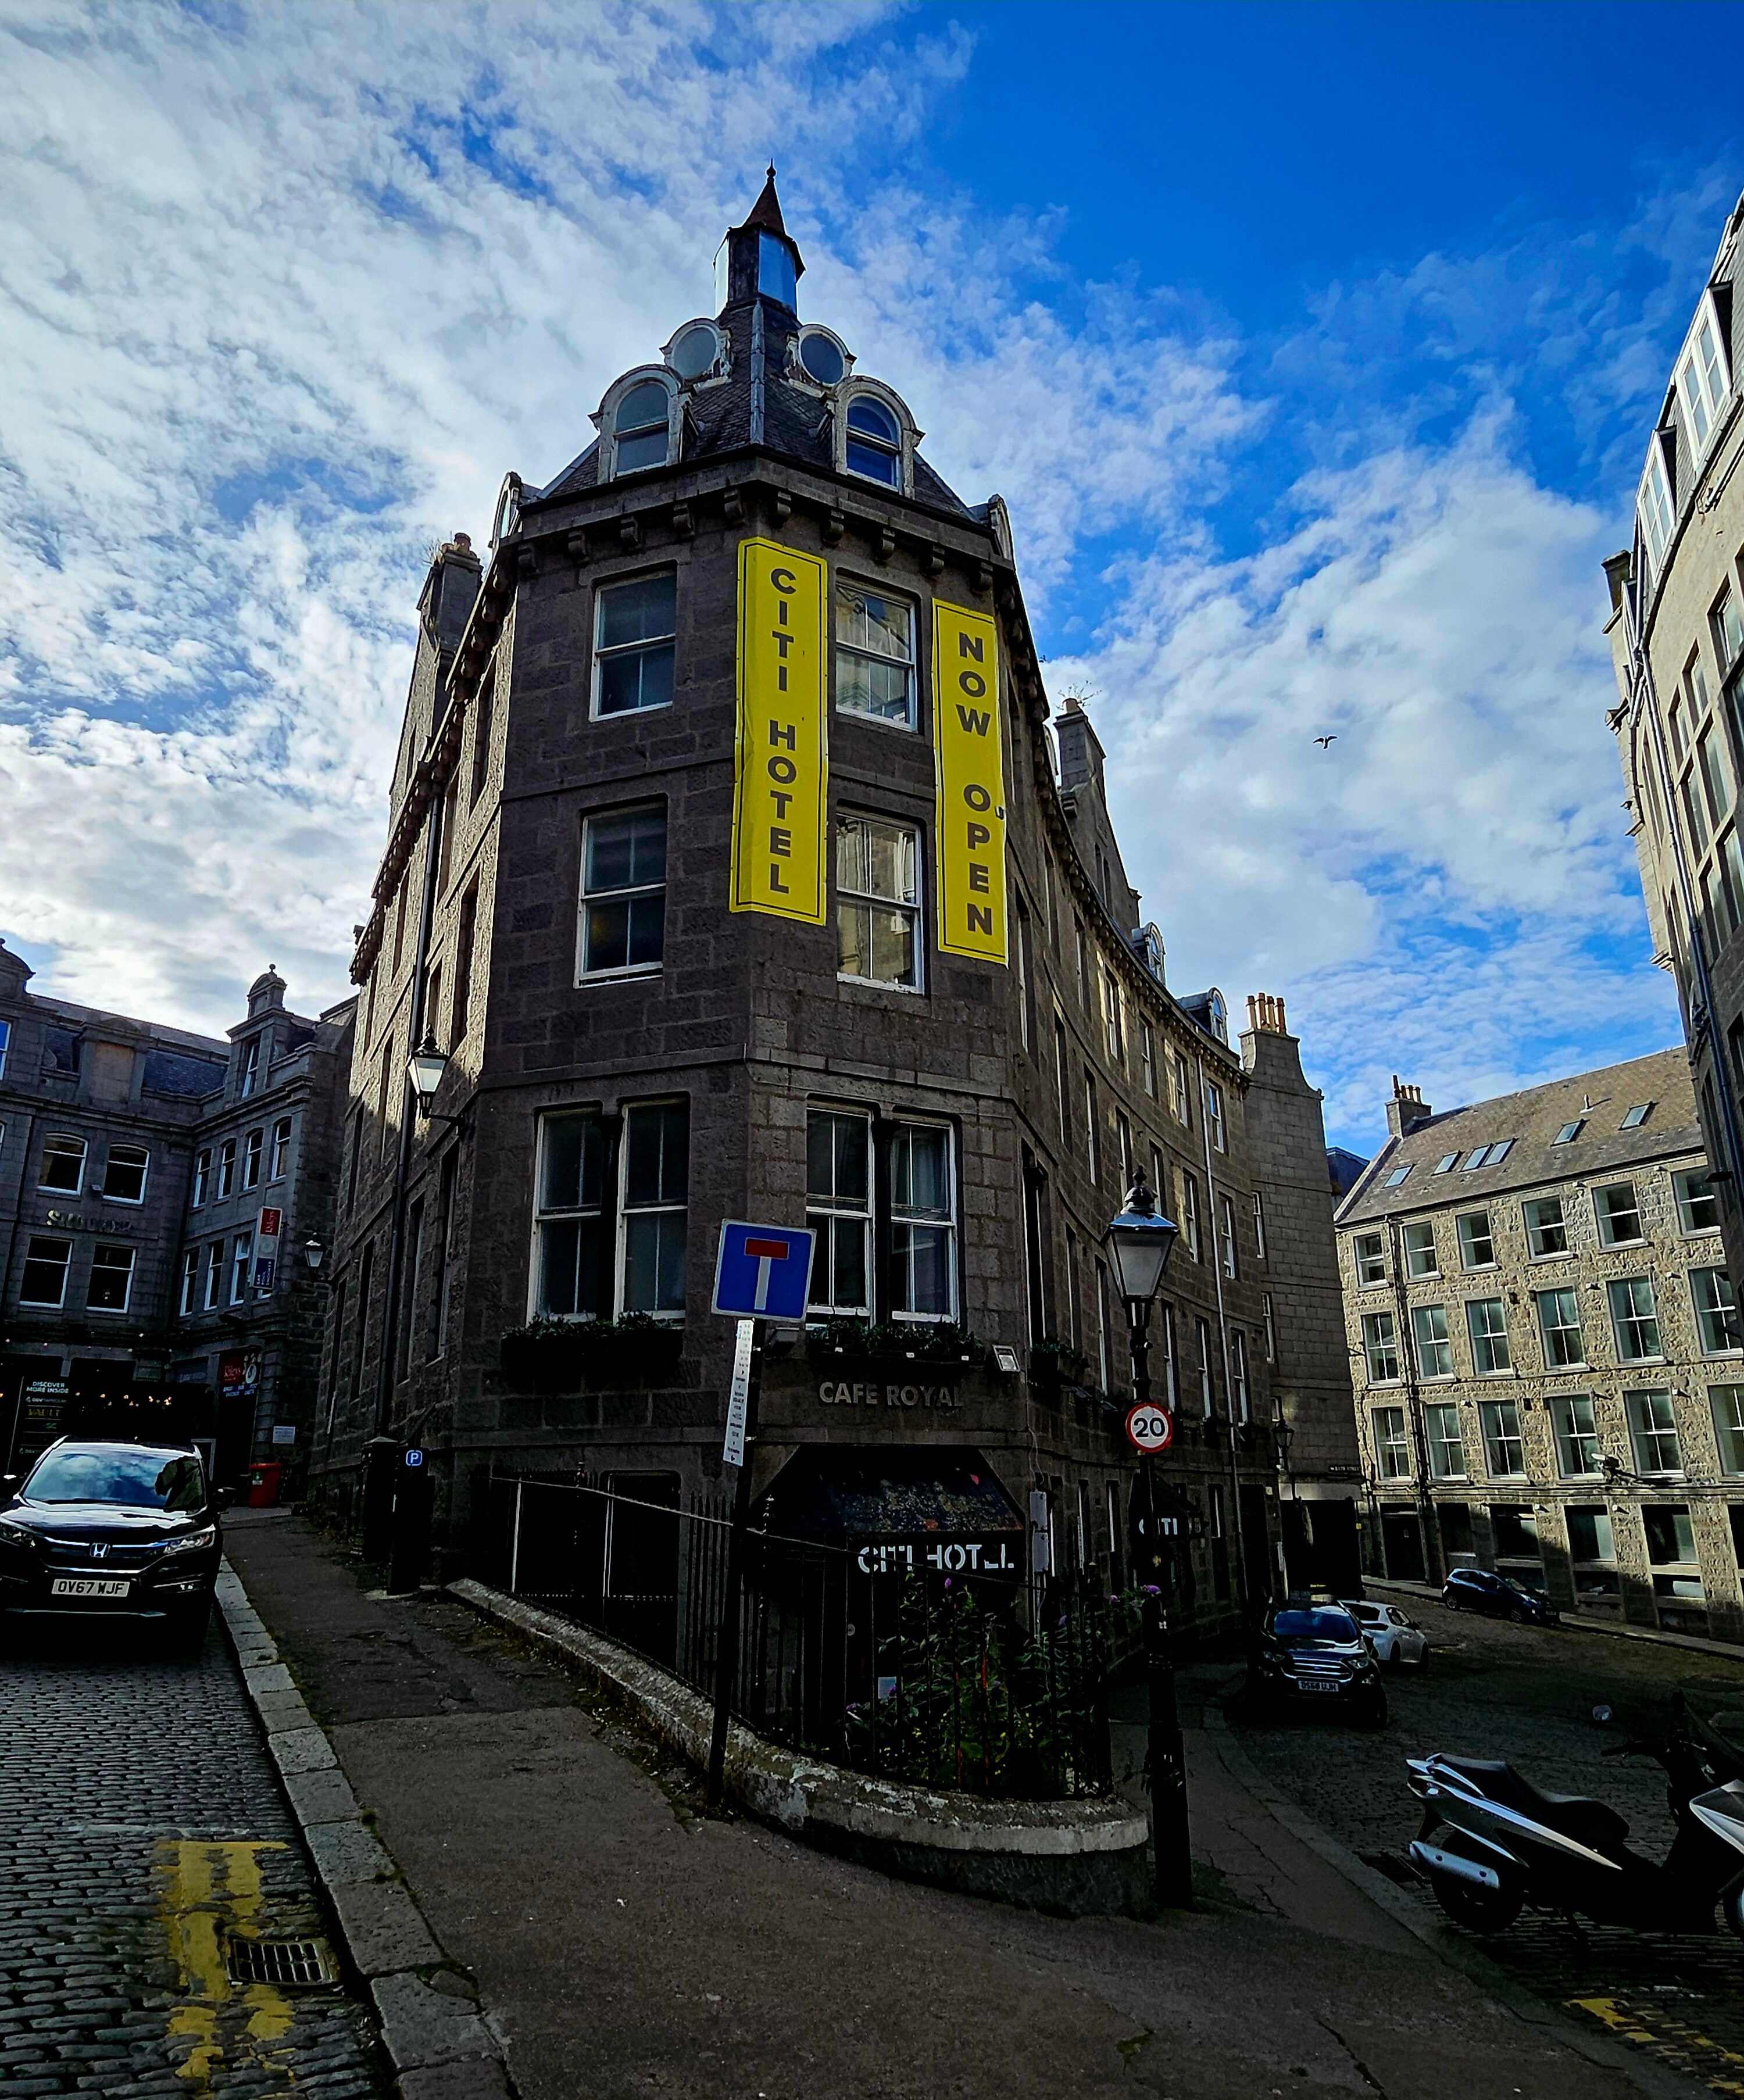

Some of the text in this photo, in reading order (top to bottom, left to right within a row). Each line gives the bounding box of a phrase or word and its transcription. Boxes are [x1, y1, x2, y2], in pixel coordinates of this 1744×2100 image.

[767, 567, 798, 895] CITI HOTEL
[955, 632, 993, 936] NOW OPEN
[819, 1382, 964, 1407] CAFE ROYAL
[1134, 1417, 1166, 1437] 20
[410, 1453, 419, 1464] P
[857, 1544, 913, 1573] CITI
[58, 1581, 125, 1594] OV67 WJF
